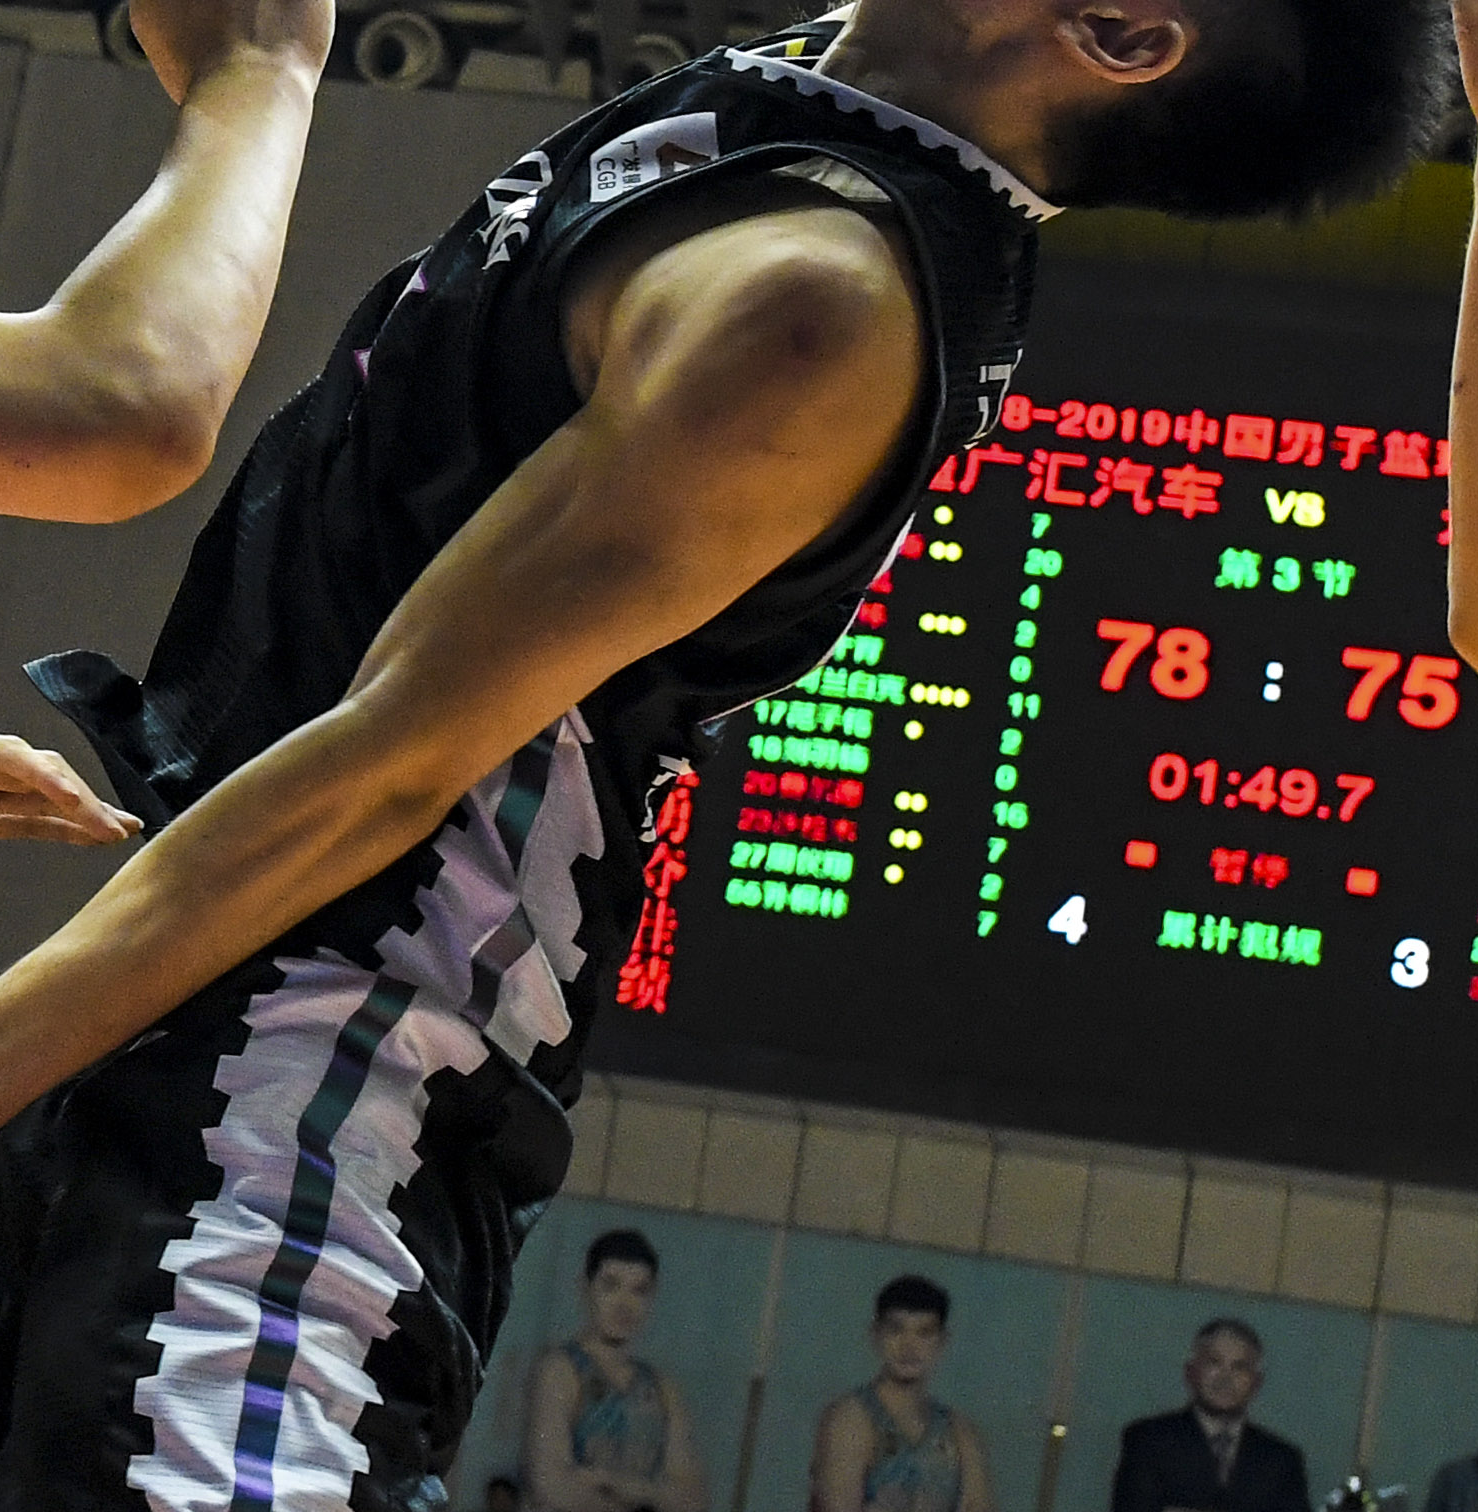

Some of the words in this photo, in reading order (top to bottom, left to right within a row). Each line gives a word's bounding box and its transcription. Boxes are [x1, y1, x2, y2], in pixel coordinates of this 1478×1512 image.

[596, 157, 617, 190] CGB
[620, 139, 642, 189] 广发银
[928, 441, 1223, 519] 广汇汽车
[1032, 512, 1053, 539] 7
[1023, 547, 1063, 577] 20
[1009, 655, 1032, 683] 0
[1096, 618, 1211, 700] 78
[1341, 646, 1461, 729] 75
[1007, 691, 1041, 719] 11
[994, 764, 1018, 791] 0
[1148, 752, 1376, 823] 01:49.7
[987, 837, 1008, 864] 7
[977, 910, 998, 937] 7
[1046, 894, 1088, 946] 4
[1157, 909, 1322, 966] 累计犯规
[1390, 937, 1430, 989] 3
